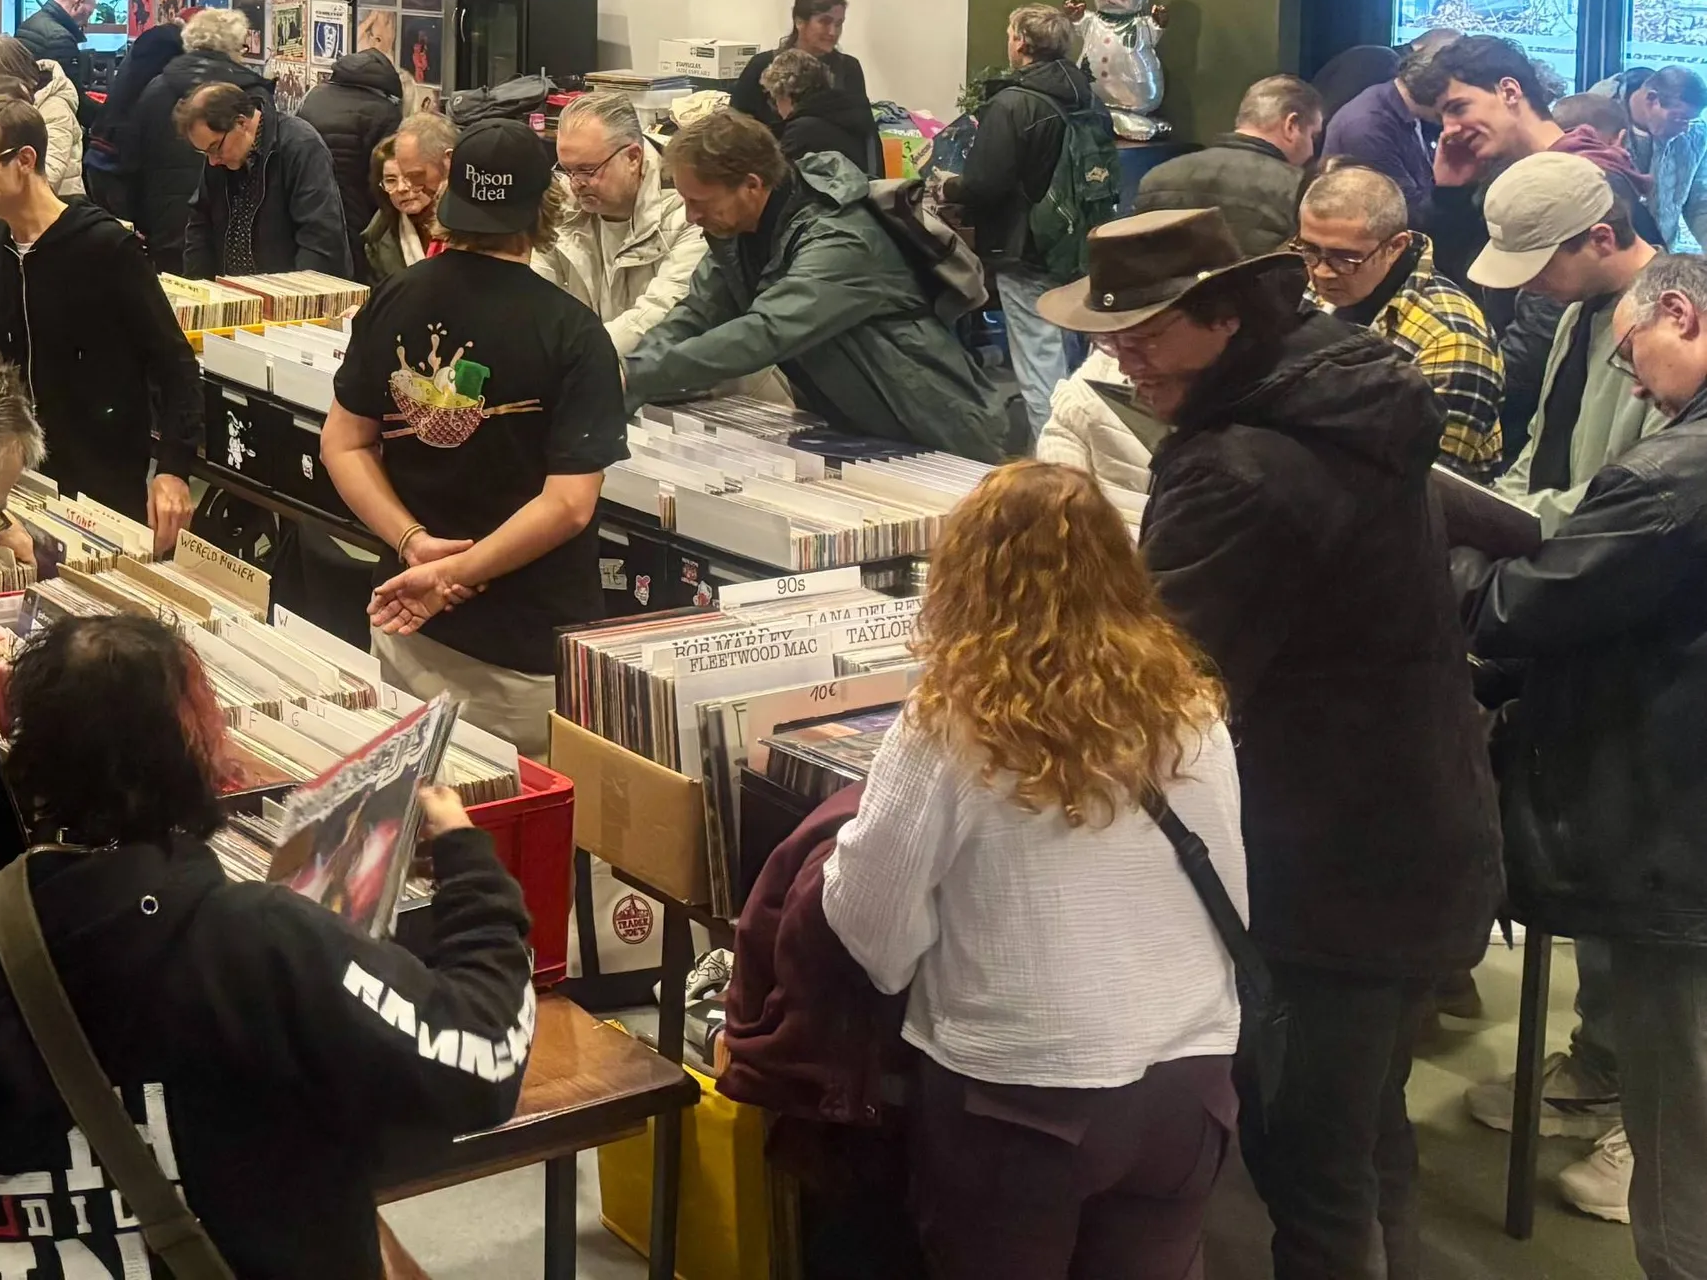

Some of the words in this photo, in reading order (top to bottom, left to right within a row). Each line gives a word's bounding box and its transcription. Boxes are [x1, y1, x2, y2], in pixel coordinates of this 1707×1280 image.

[465, 163, 513, 188] Poison
[471, 181, 506, 201] Idea
[181, 534, 218, 562] WERELD
[777, 577, 806, 595] 90s
[278, 611, 289, 628] W
[805, 608, 851, 627] LANA
[846, 619, 913, 645] TAYLOR
[674, 641, 710, 658] BOB
[689, 645, 780, 673] FLEETWOOD
[783, 638, 818, 658] MAC
[810, 681, 837, 702] 10€
